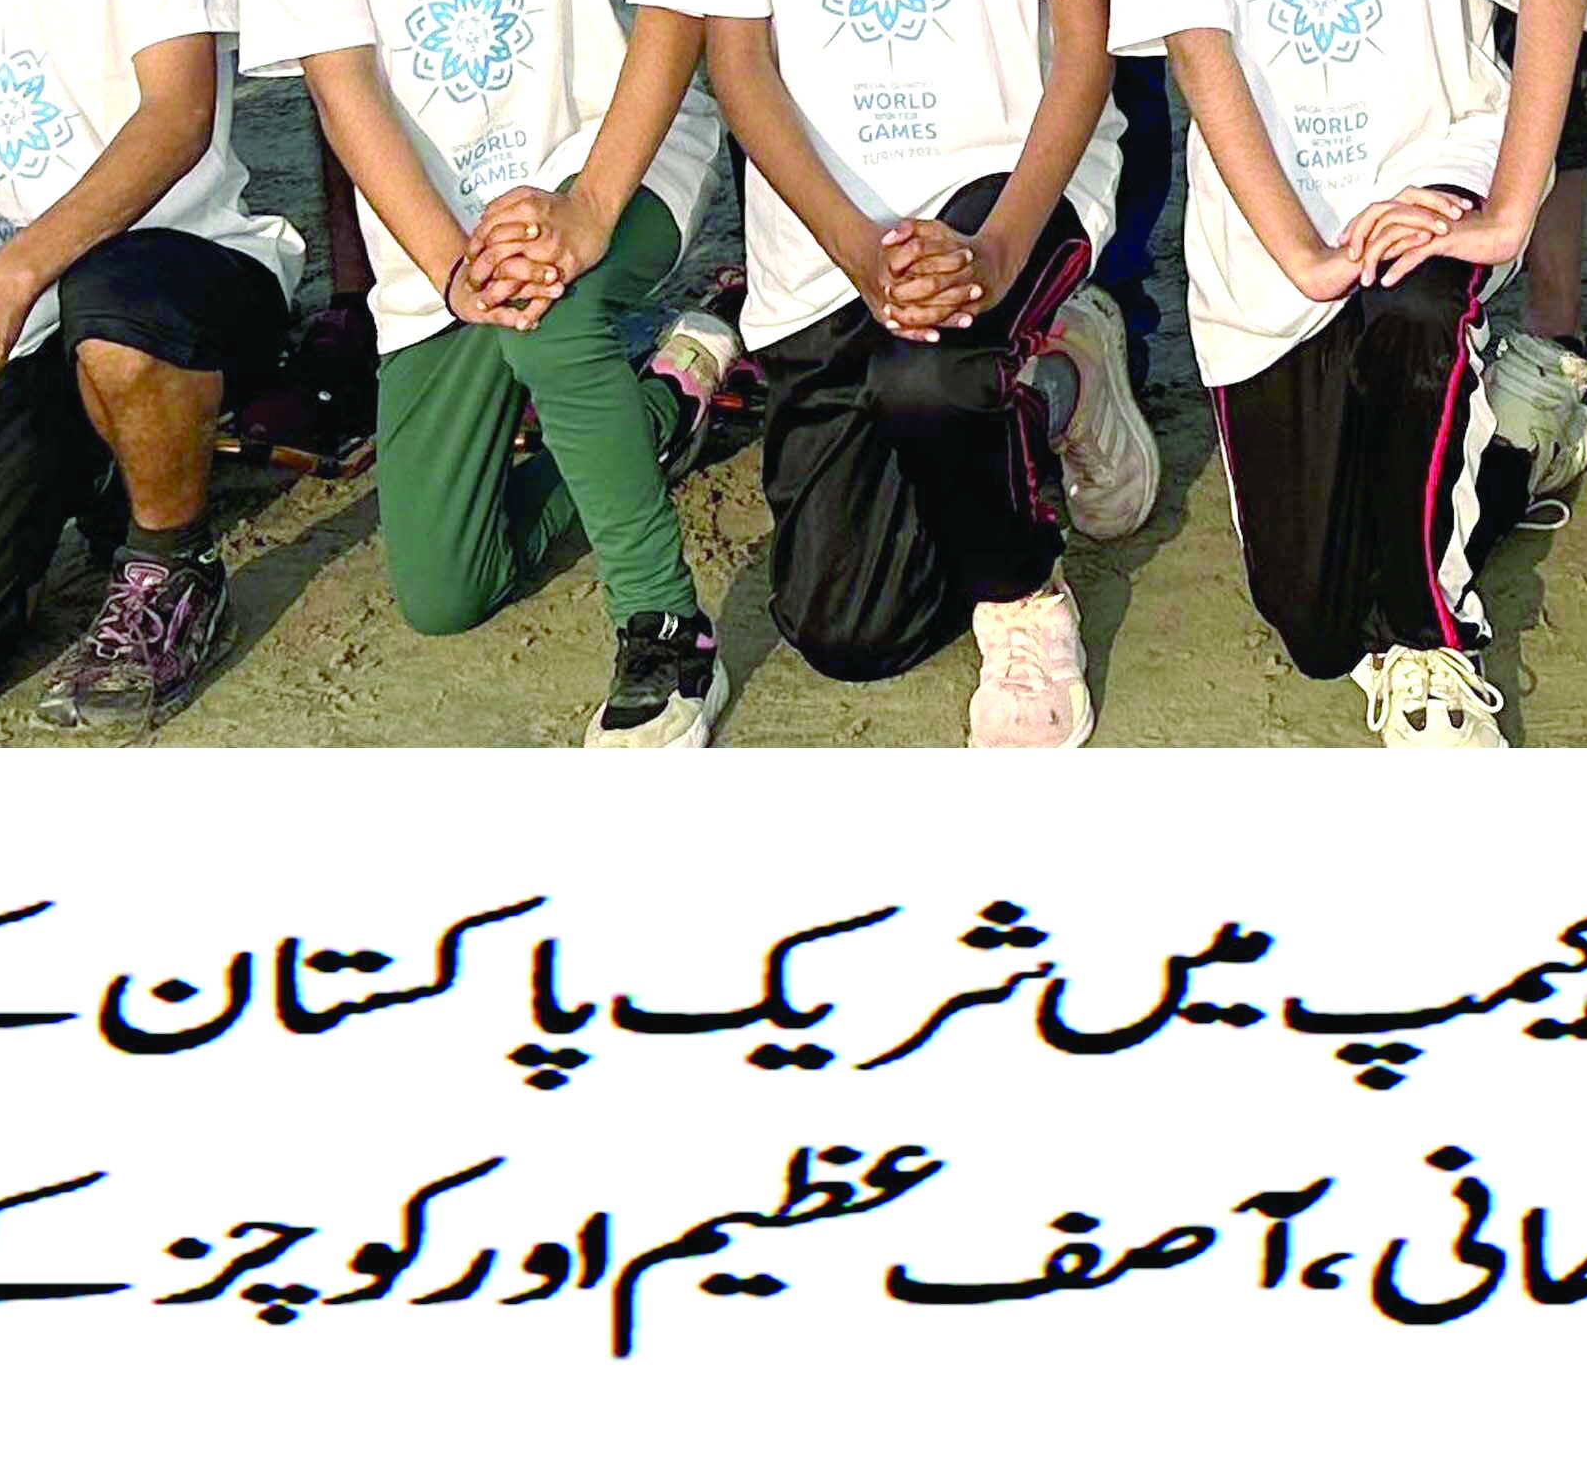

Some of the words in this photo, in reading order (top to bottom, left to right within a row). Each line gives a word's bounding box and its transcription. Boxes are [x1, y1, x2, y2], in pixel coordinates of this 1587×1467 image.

[854, 92, 937, 110] WORLD
[858, 123, 937, 143] GAMES
[1294, 112, 1369, 135] WORLD
[453, 130, 527, 171] WORLD
[1296, 143, 1368, 168] GAMES
[459, 161, 529, 196] GAMES
